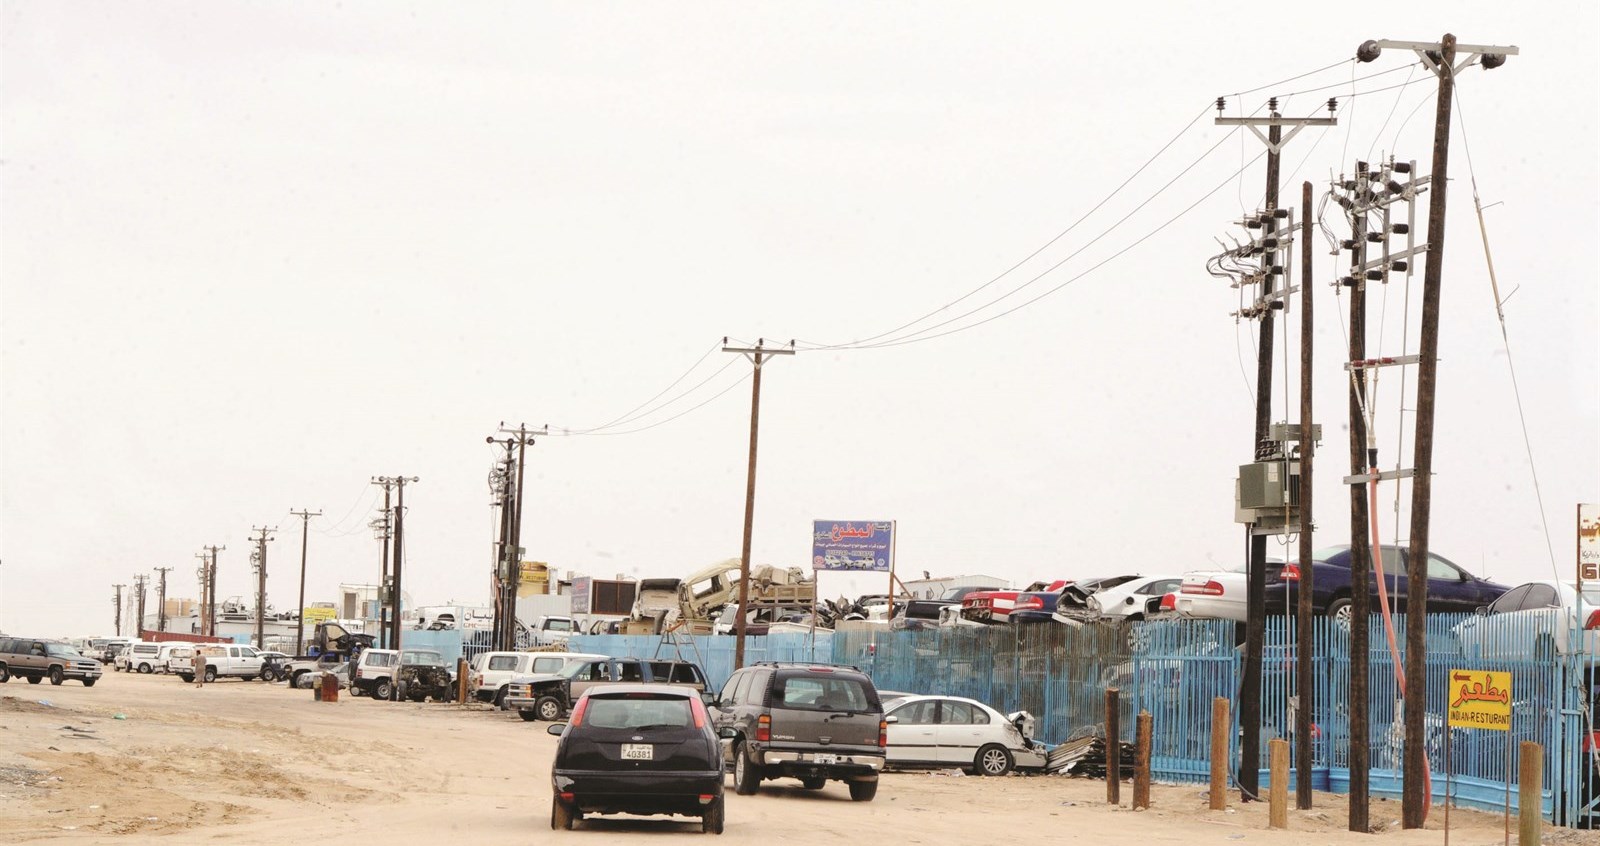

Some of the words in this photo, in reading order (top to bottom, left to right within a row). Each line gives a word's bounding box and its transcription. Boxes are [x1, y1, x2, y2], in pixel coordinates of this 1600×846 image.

[832, 522, 874, 542] المطوع
[1452, 674, 1508, 708] مطعم
[626, 751, 651, 759] 40381
